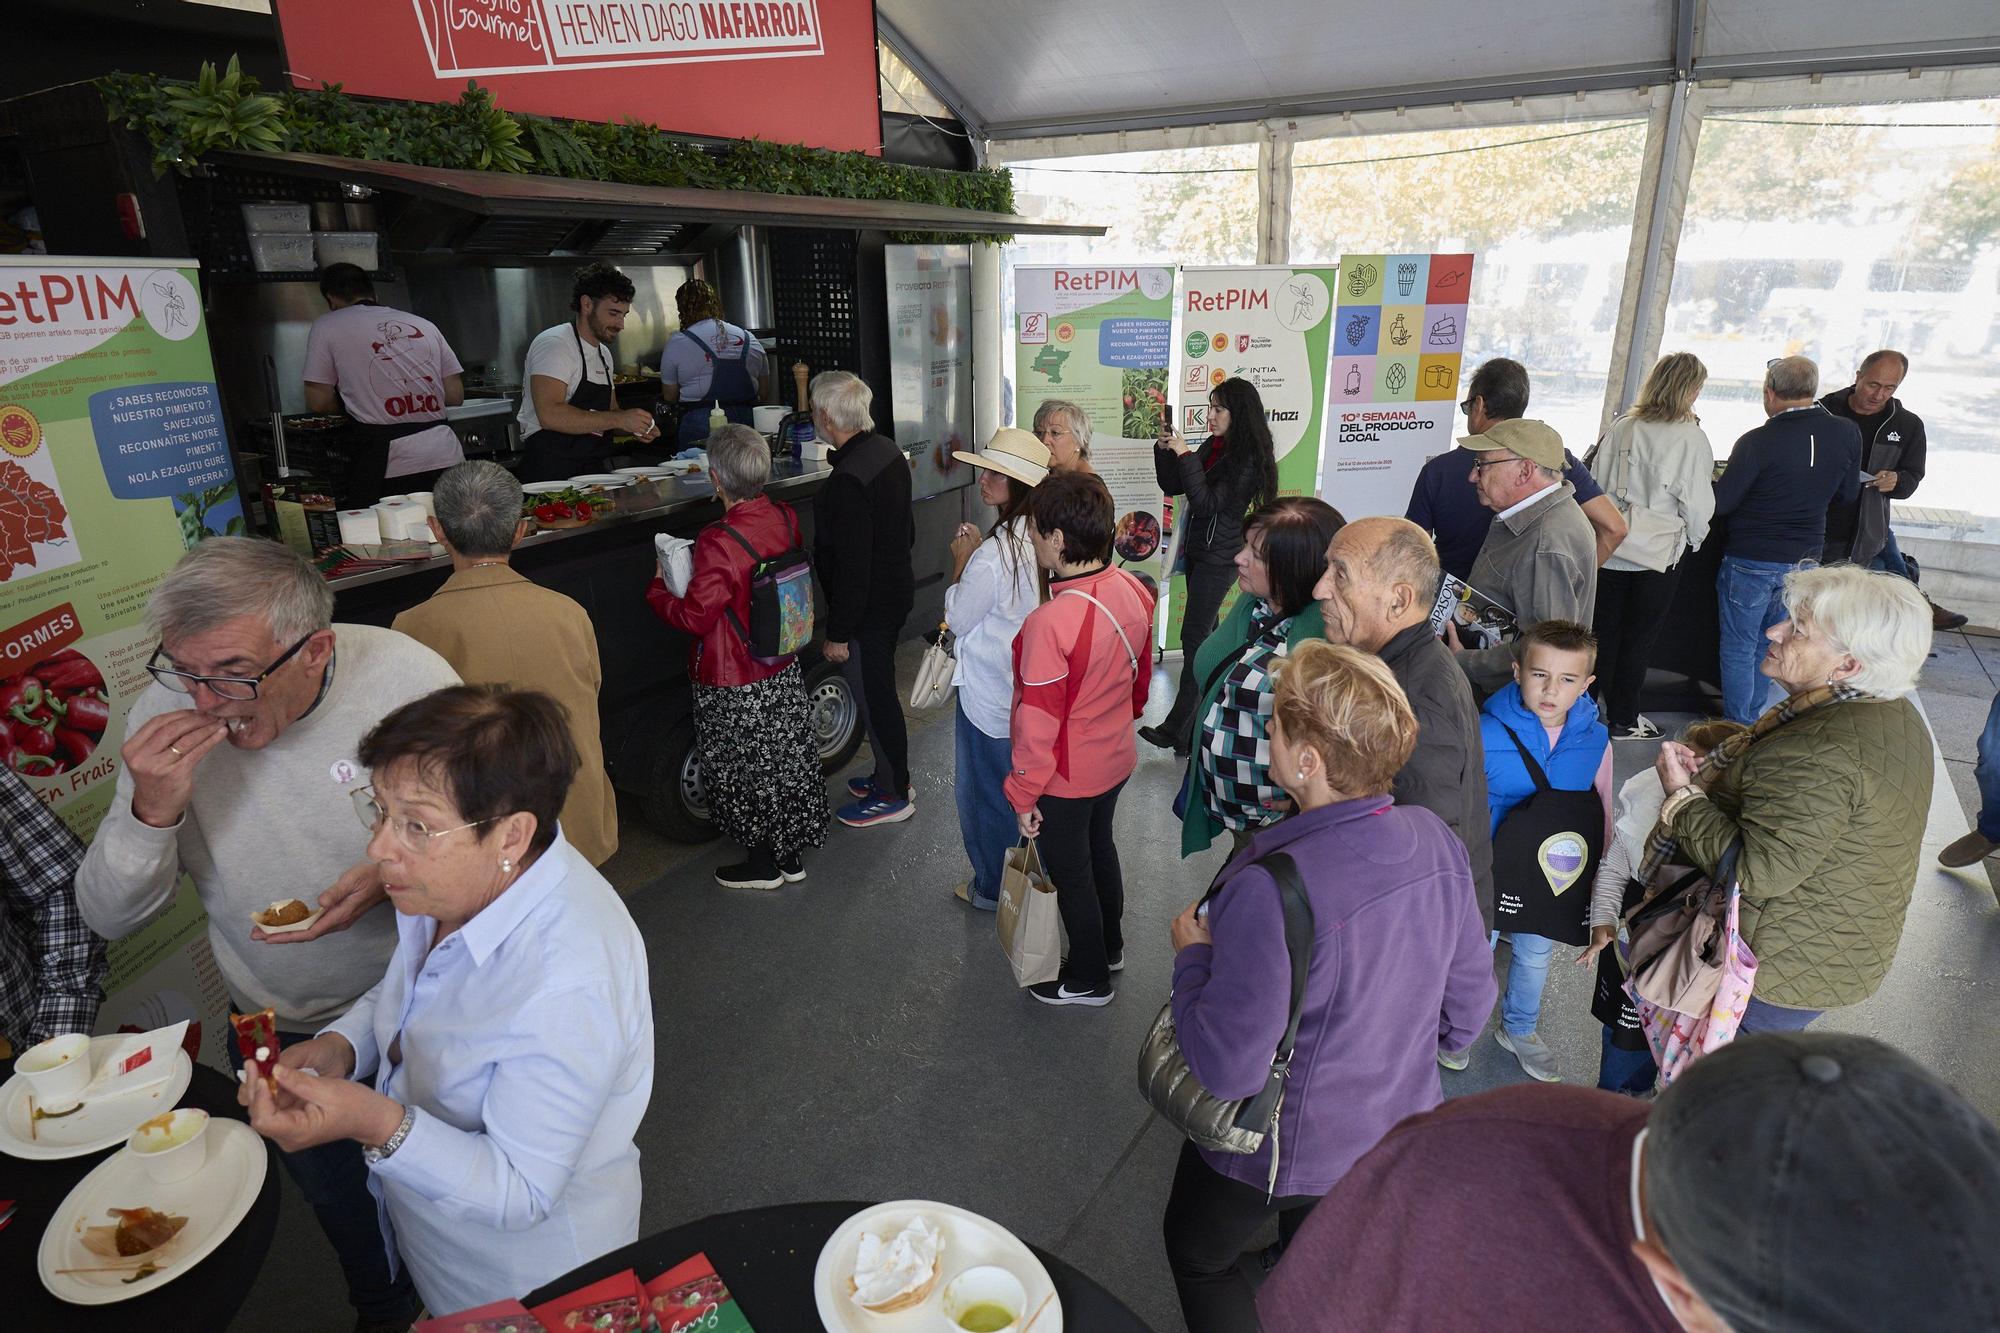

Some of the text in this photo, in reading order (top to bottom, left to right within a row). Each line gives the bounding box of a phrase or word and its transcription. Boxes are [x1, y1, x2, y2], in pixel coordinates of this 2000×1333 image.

[450, 7, 542, 51] Gourmet
[555, 2, 811, 46] HEMEN DAGO NAFARROA
[1054, 270, 1139, 291] RetPIM
[1188, 288, 1268, 312] RetPIM
[1250, 366, 1277, 374] INTIA
[117, 393, 154, 407] SABES
[155, 386, 209, 401] RECONOCER
[112, 408, 164, 423] NUESTRO
[166, 401, 205, 415] PIMIENTO
[1271, 409, 1299, 422] hazi
[1362, 411, 1416, 421] SEMANA
[163, 414, 216, 431] SAVEZ-VOUS
[1340, 421, 1434, 432] DEL PRODUCTO
[191, 428, 219, 441] NOTRE
[1339, 433, 1380, 442] LOCAL
[186, 443, 216, 457] PIMENT
[128, 455, 226, 484] NOLA EZAGUTU GURE
[187, 471, 223, 487] BIPERRA
[70, 756, 115, 792] Frais
